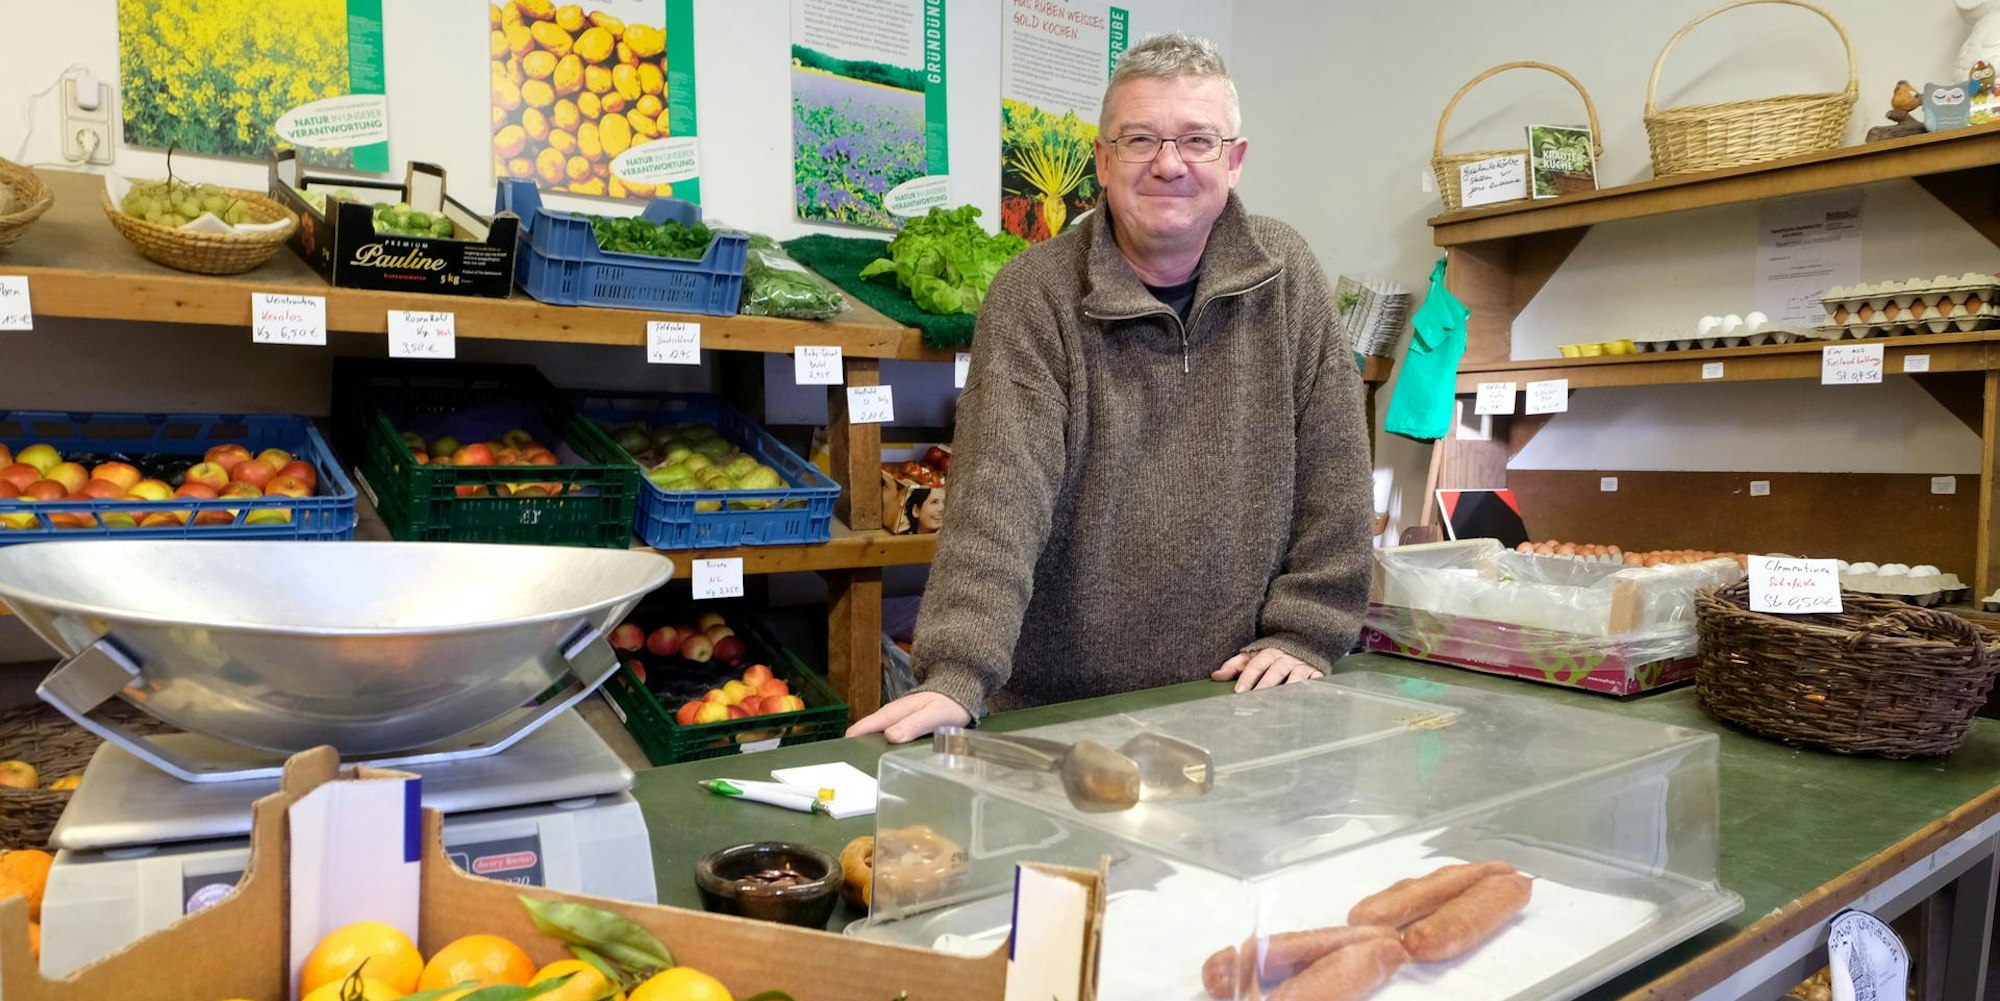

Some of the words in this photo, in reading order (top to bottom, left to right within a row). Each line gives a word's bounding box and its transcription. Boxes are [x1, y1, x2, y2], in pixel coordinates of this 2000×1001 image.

[1013, 11, 1039, 29] GOLD
[1043, 21, 1078, 39] KOCHEN
[294, 115, 330, 128] NATUR
[287, 119, 383, 138] VERANTWORTUNG
[620, 158, 696, 176] VERANTWORTUNG
[626, 156, 654, 167] NATUR
[384, 239, 429, 249] PREMIUM
[350, 243, 447, 271] Pauline
[440, 273, 447, 284] 5
[447, 273, 460, 286] kg
[477, 858, 503, 868] Avery
